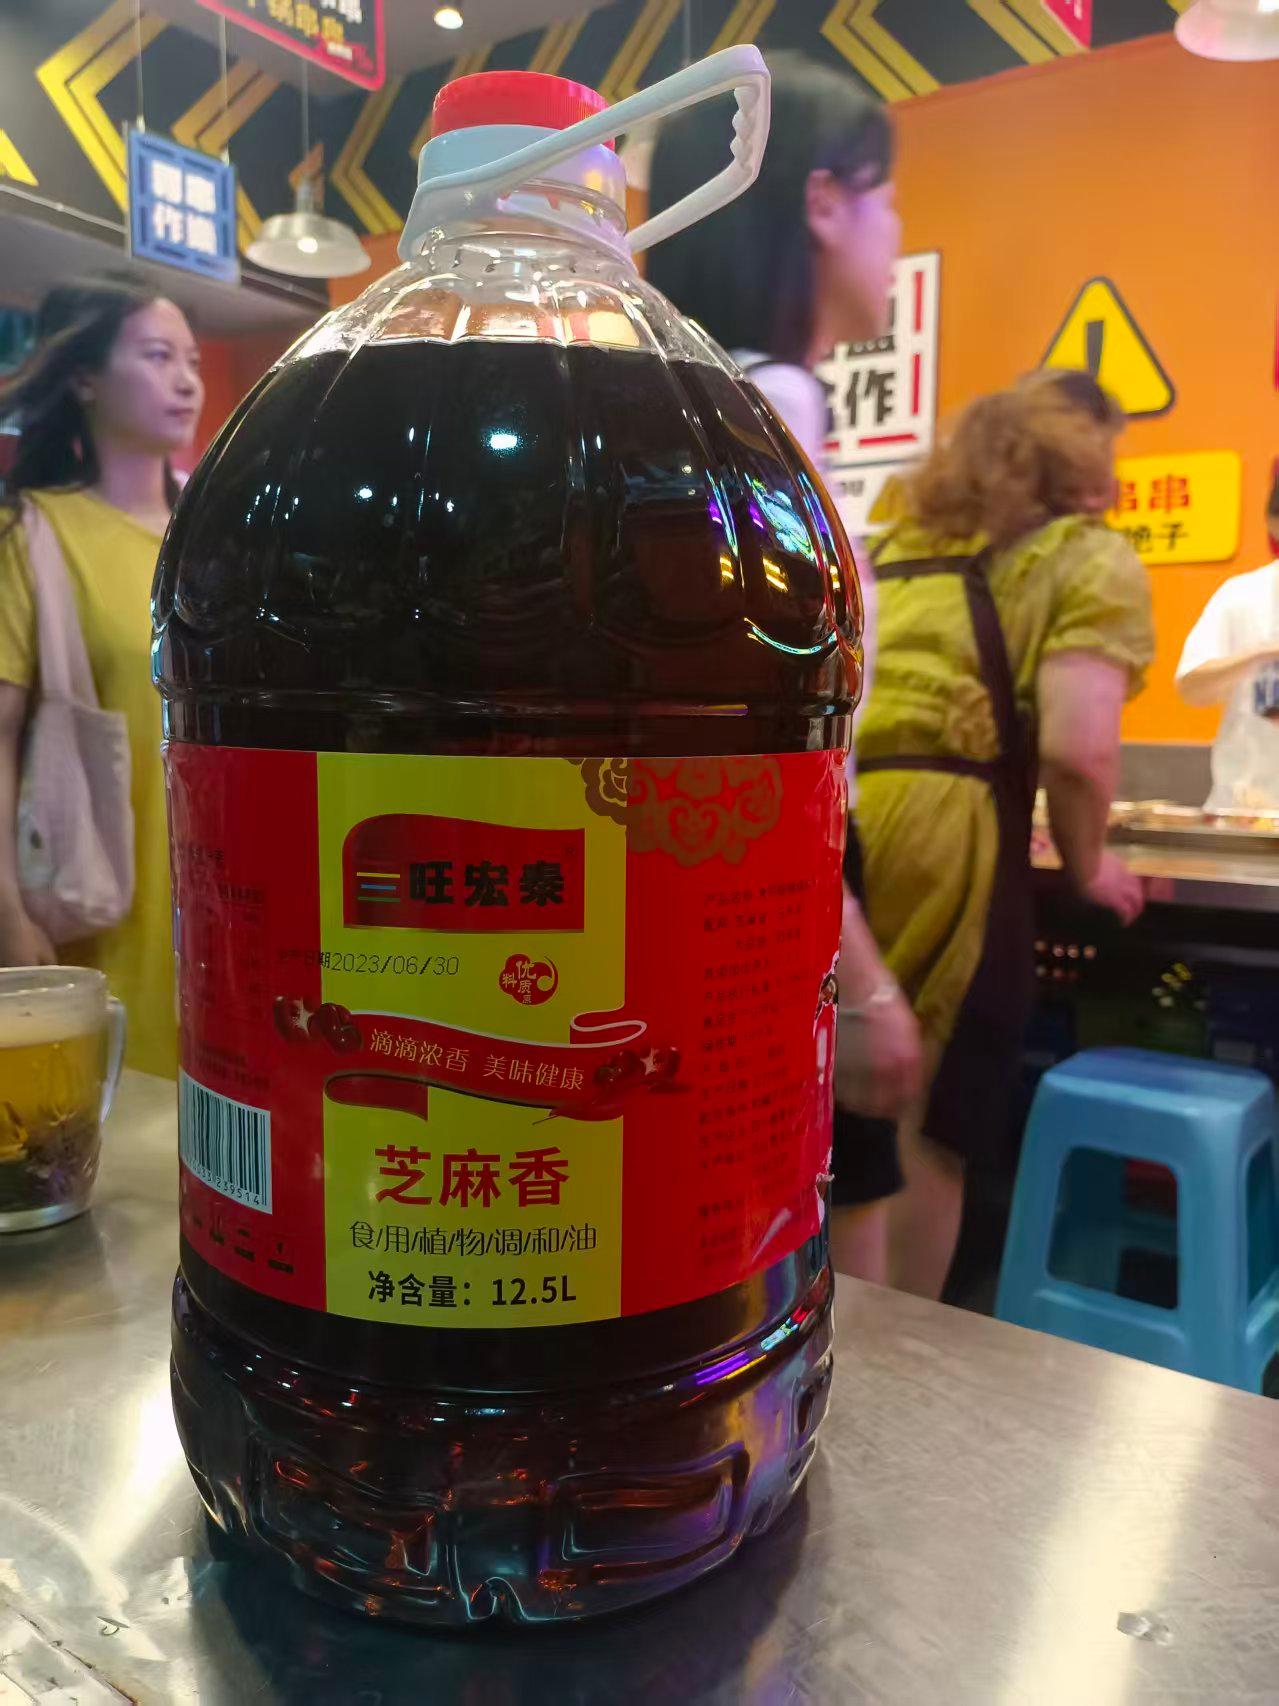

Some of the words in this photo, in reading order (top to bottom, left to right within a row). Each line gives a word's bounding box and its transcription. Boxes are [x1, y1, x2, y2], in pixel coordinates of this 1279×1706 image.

[370, 1028, 470, 1073] 滴滴浓香
[482, 1053, 585, 1091] 美味健康
[375, 1144, 570, 1208] 芝麻香
[349, 1221, 598, 1257] 食/用/植/物/调/和/油
